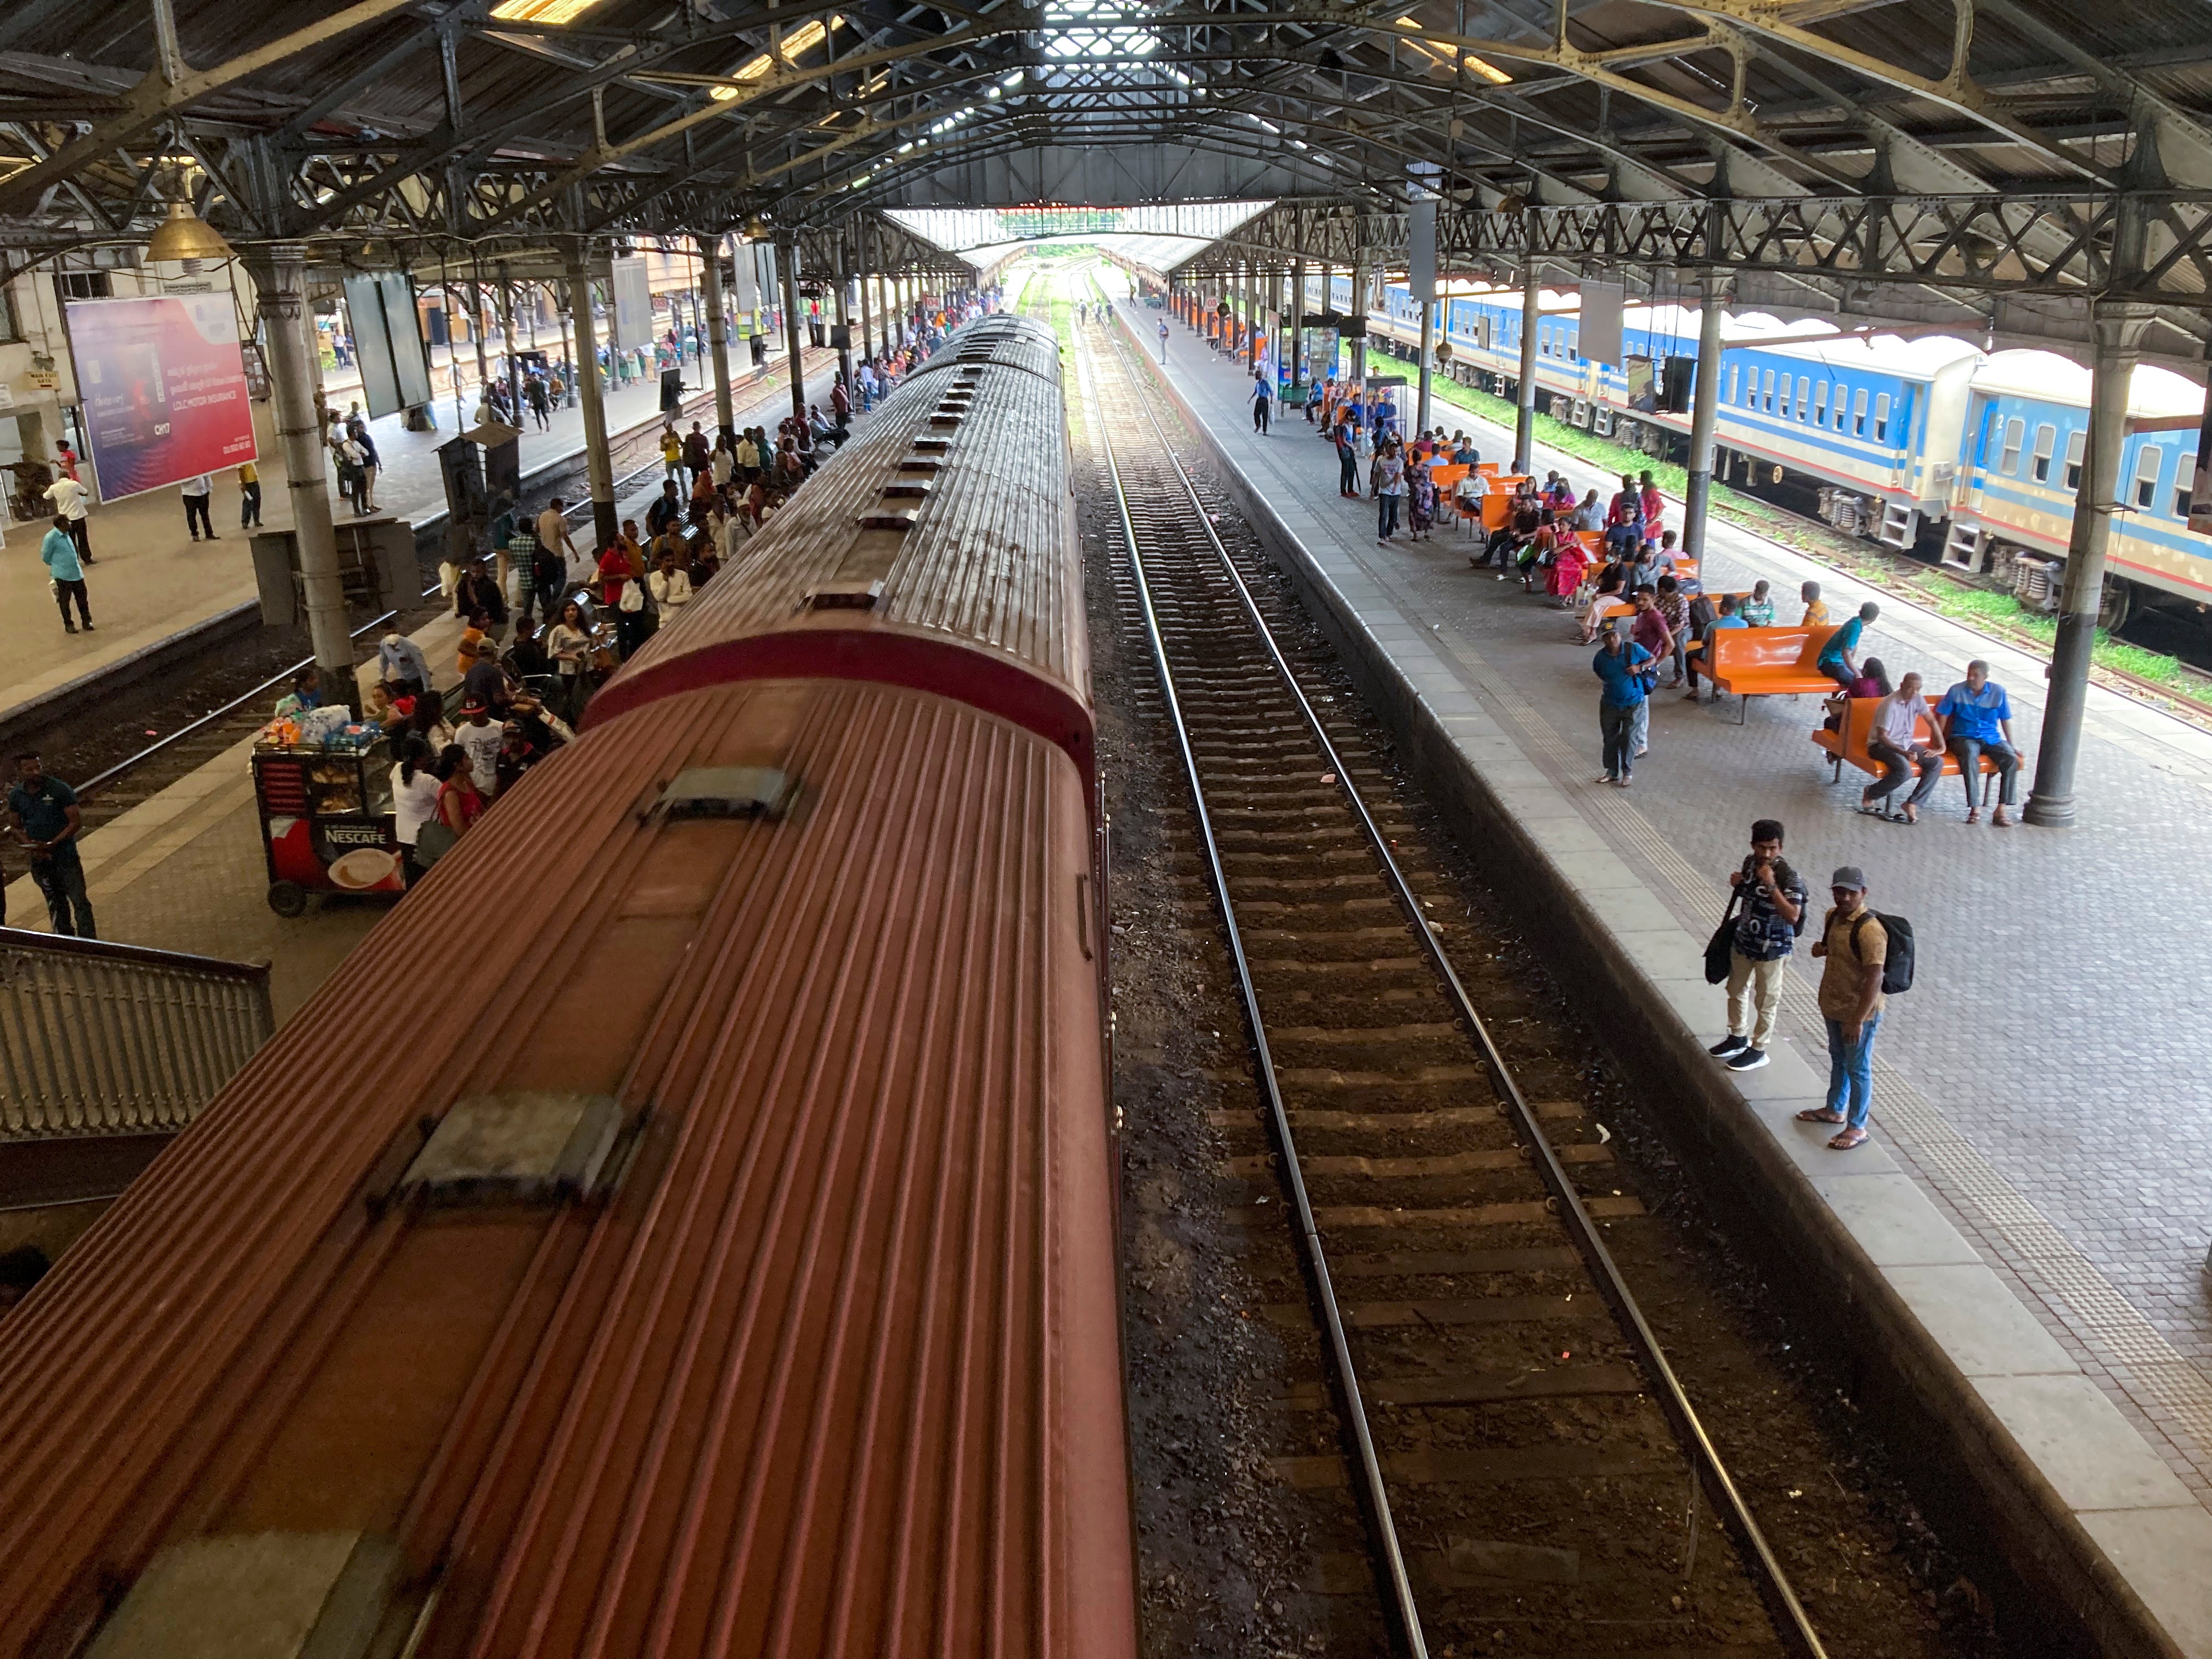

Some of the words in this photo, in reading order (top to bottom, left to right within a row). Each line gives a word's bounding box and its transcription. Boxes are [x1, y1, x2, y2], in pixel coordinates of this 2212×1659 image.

[654, 299, 665, 307] 03
[1207, 298, 1216, 307] 05
[1999, 414, 2004, 429] 2
